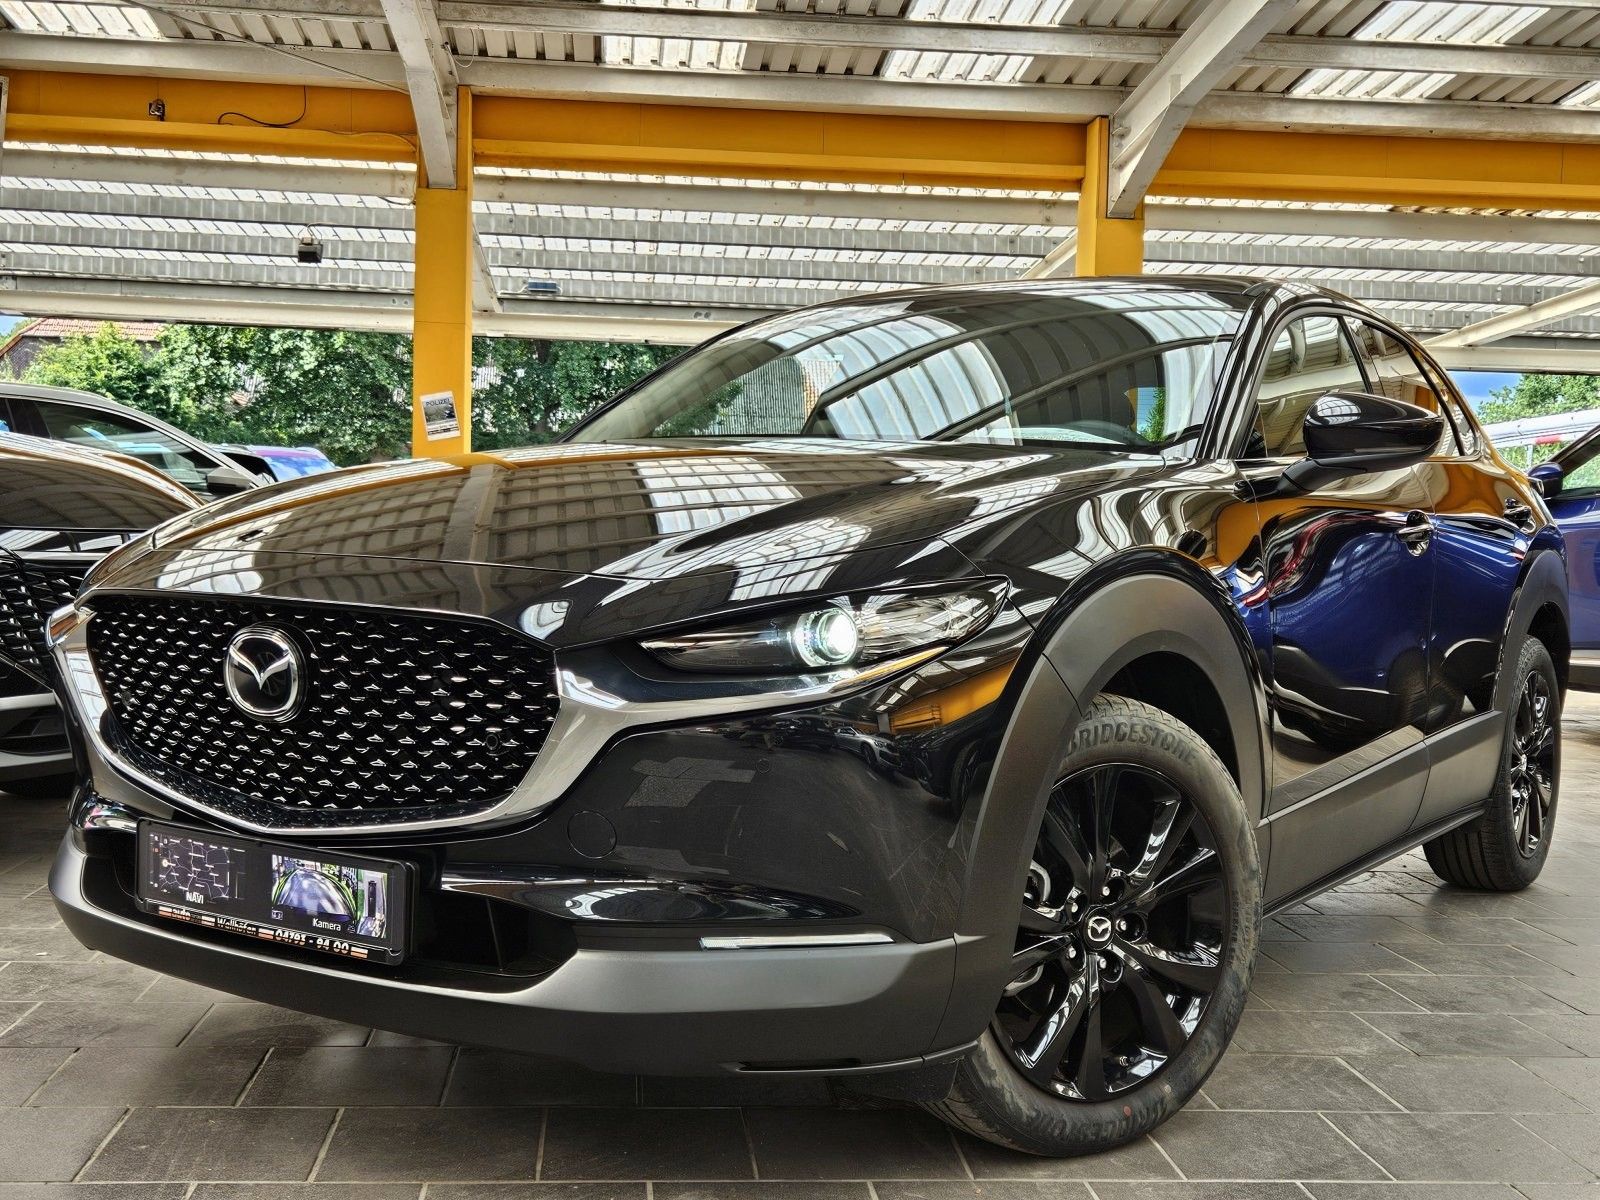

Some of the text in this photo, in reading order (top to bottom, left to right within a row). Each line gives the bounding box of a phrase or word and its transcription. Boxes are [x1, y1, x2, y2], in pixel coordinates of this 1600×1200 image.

[426, 398, 450, 407] POLIZEI
[186, 891, 204, 904] NAVI
[312, 917, 341, 931] Kamera
